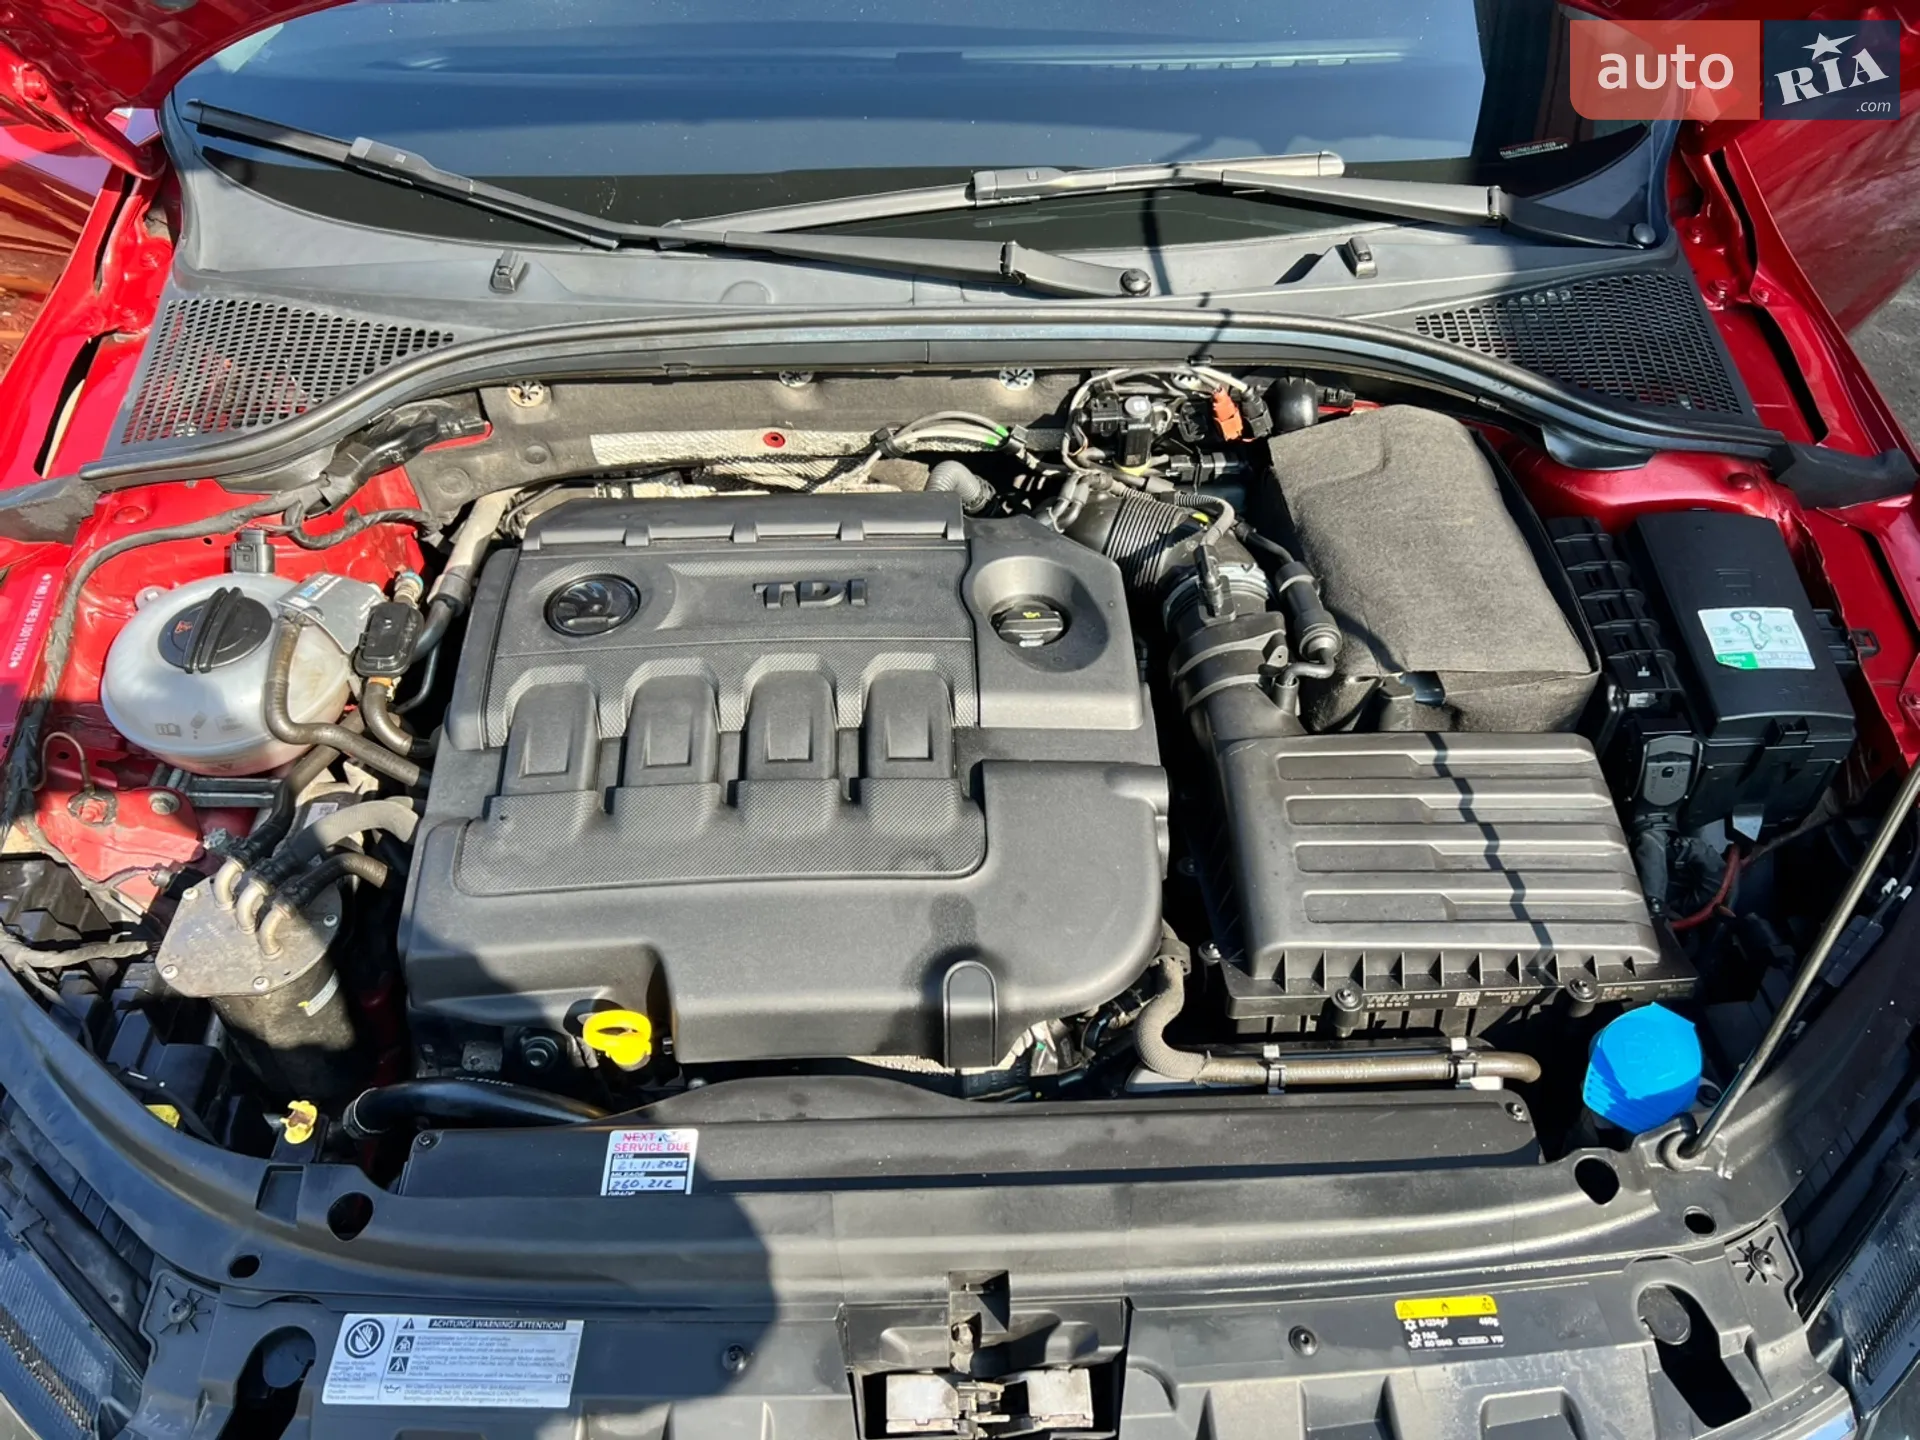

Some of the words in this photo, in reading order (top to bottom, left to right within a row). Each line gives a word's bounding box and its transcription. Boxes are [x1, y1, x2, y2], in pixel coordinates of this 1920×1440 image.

[752, 578, 868, 609] TDI
[623, 1132, 656, 1142] NEXT
[613, 1142, 663, 1151] SERVICE
[666, 1142, 691, 1151] DUE
[432, 1319, 474, 1328] ACHTUNG!
[475, 1320, 516, 1328] WARNING!
[518, 1320, 564, 1329] ATTENTION!
